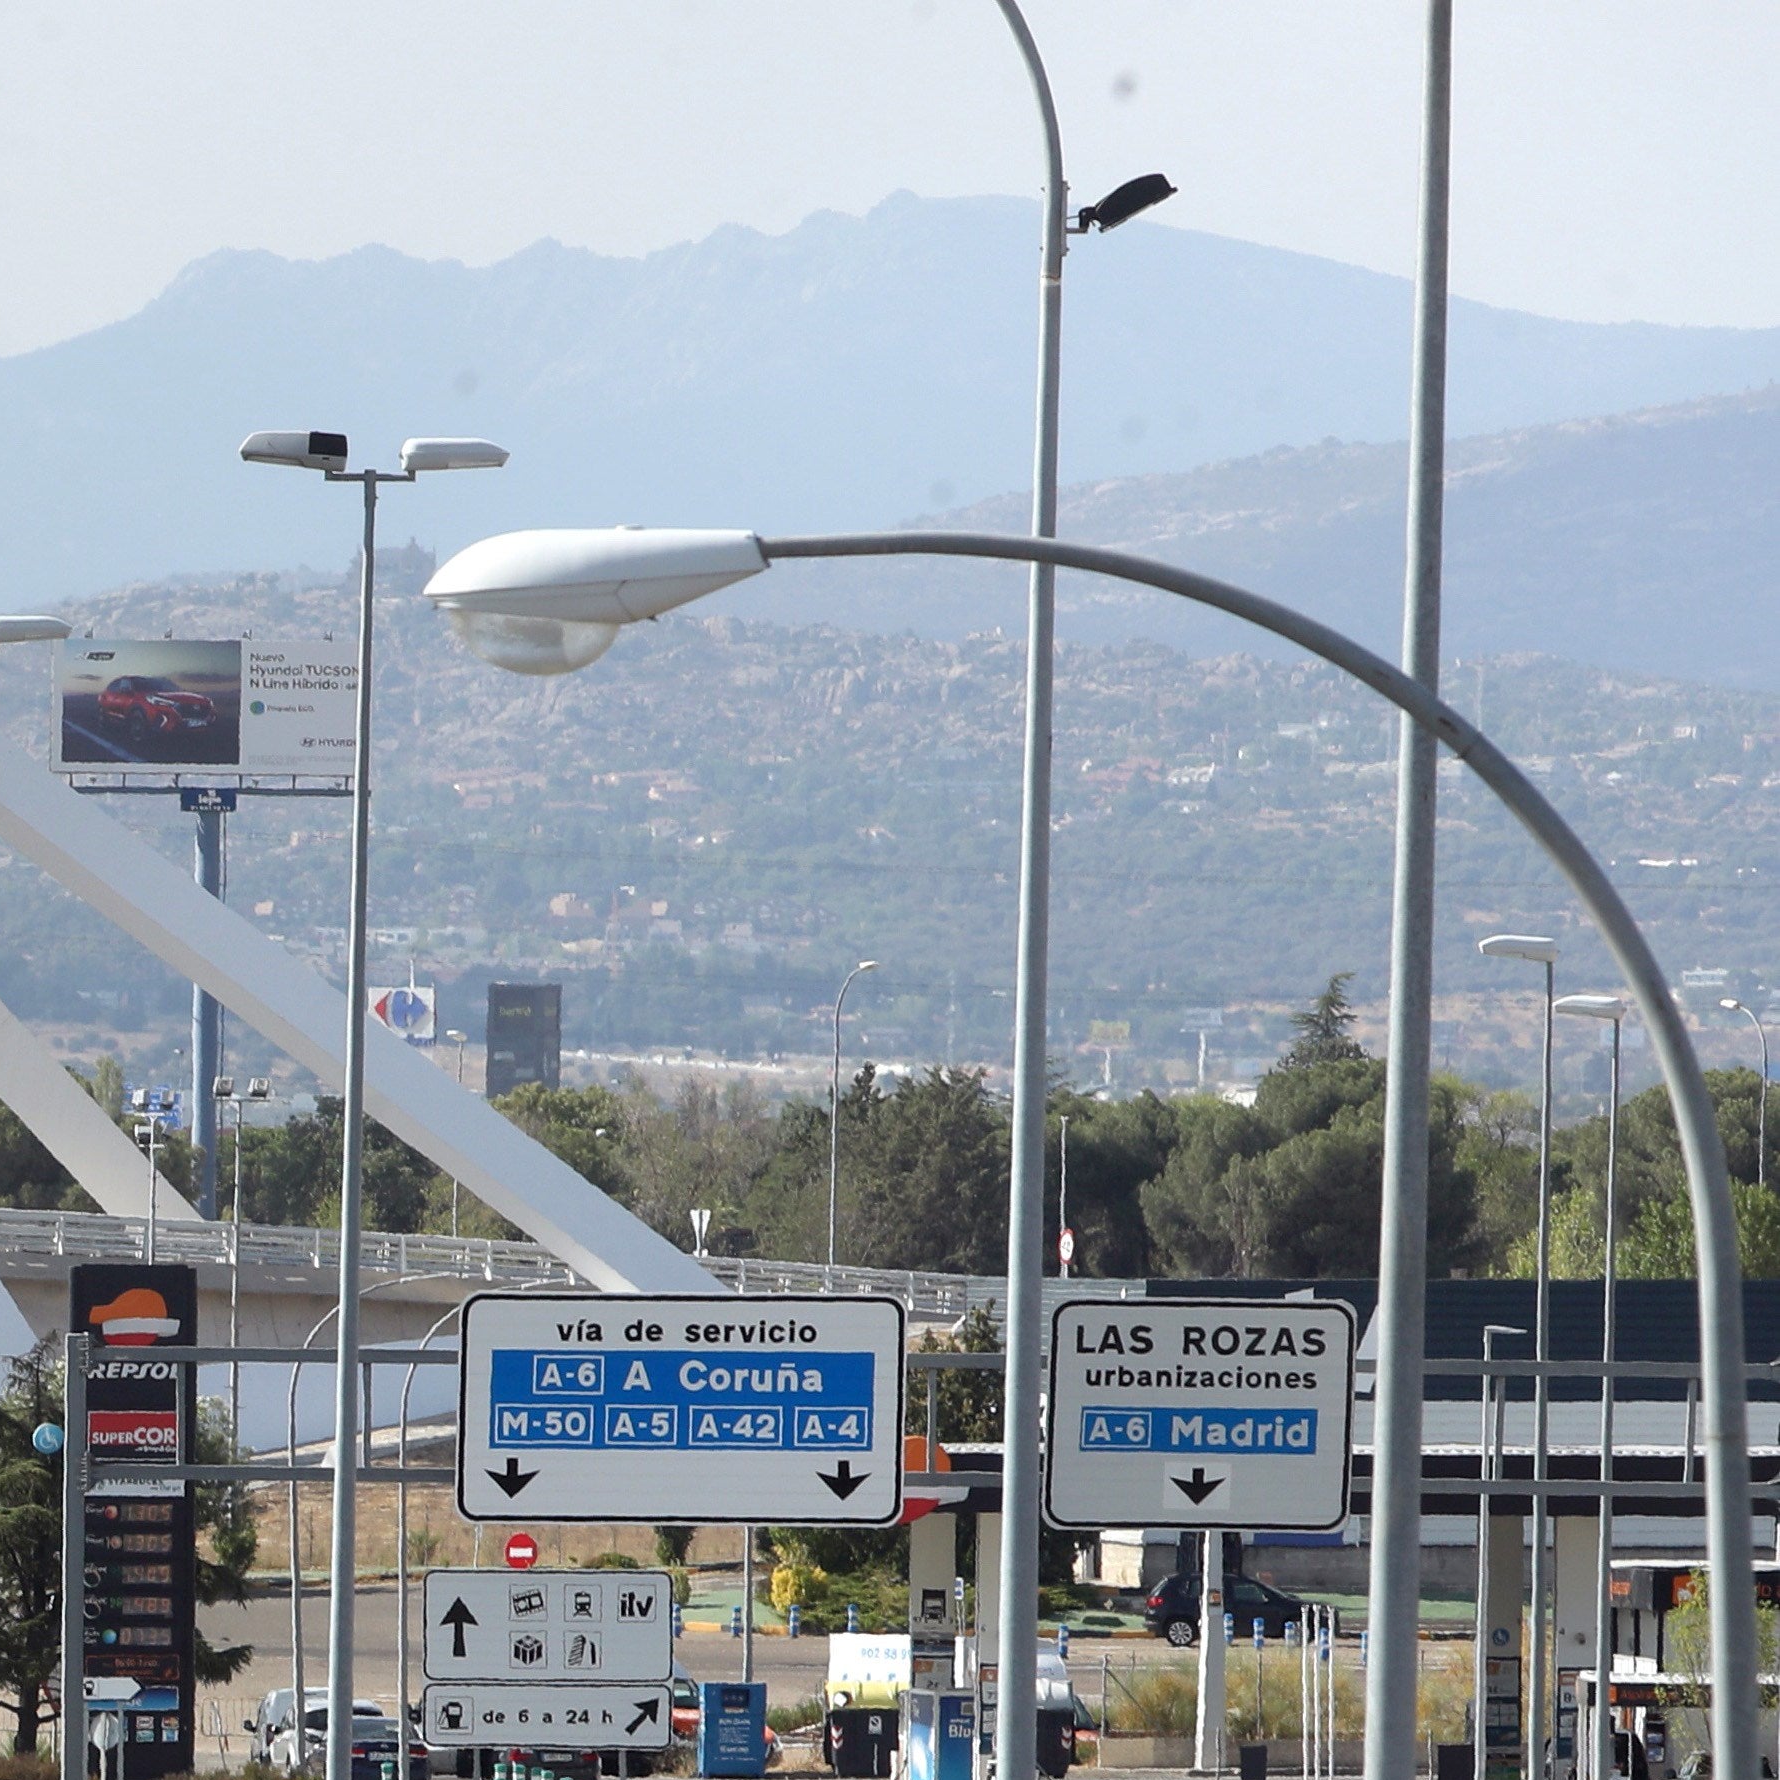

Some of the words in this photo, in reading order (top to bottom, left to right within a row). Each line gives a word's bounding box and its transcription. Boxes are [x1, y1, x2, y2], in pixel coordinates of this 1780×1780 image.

[557, 1318, 602, 1343] vía
[624, 1318, 664, 1343] de
[685, 1319, 818, 1344] servicio
[1076, 1325, 1154, 1355] LAS
[1183, 1325, 1327, 1357] ROZAS
[540, 1360, 598, 1389] A-6
[622, 1360, 652, 1391] A
[679, 1358, 824, 1393] Coruña
[1086, 1365, 1318, 1390] urbanizaciones
[92, 1427, 176, 1445] SUPERCOR
[501, 1410, 587, 1438] M-50
[612, 1411, 670, 1438] A-5
[697, 1413, 775, 1440] A-42
[802, 1414, 860, 1440] A-4
[1089, 1416, 1146, 1442] A-6
[1170, 1415, 1310, 1450] Madrid
[482, 1709, 505, 1725] de
[519, 1710, 529, 1724] 6
[542, 1713, 553, 1725] a
[566, 1710, 590, 1724] 24
[602, 1709, 613, 1724] h
